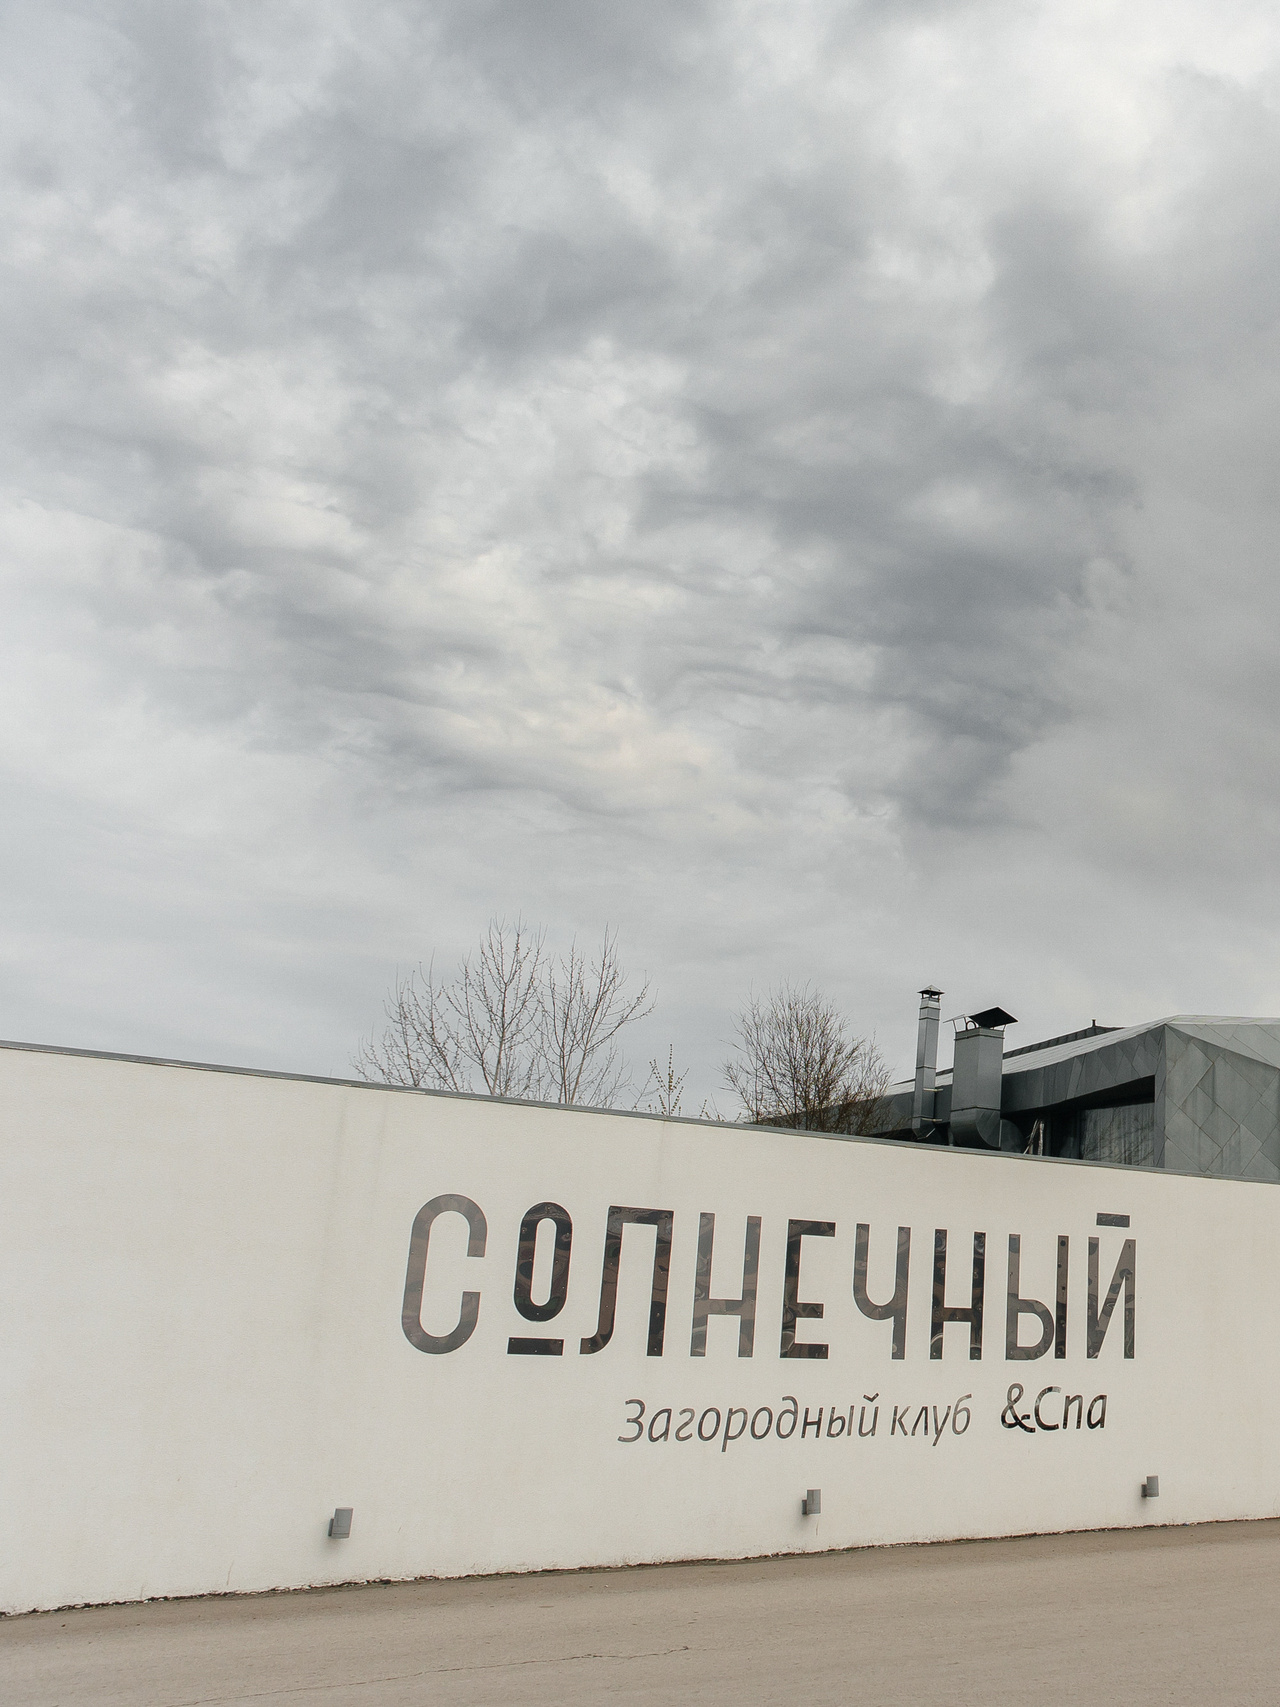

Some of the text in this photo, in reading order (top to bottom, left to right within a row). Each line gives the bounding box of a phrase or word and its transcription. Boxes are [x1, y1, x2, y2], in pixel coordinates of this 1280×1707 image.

[402, 1194, 1136, 1360] СОЛНЕЧНЫЙ
[617, 1383, 1108, 1453] Загородный клуб &Спа
